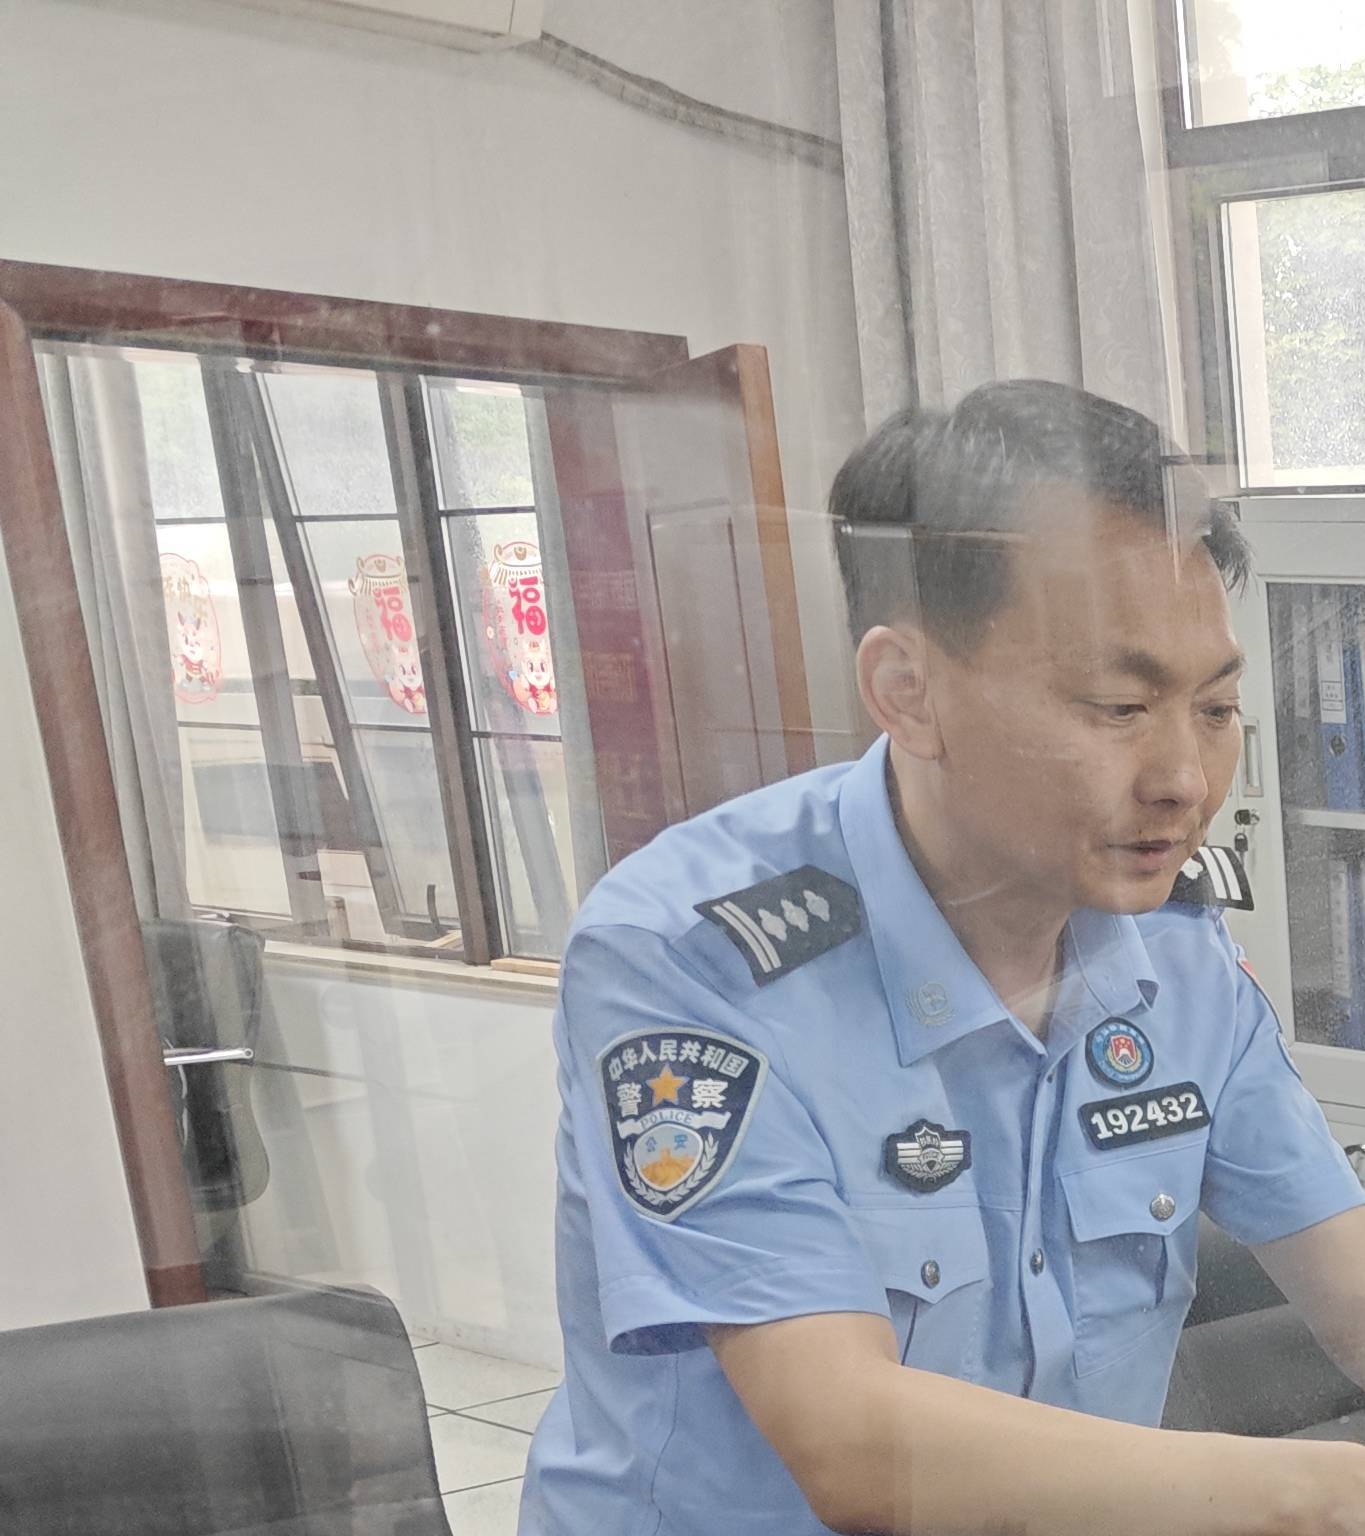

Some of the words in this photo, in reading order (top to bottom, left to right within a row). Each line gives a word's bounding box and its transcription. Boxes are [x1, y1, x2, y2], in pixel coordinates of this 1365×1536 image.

[608, 1039, 749, 1081] 中华人民共和国
[616, 1078, 728, 1117] 警察
[1091, 1093, 1203, 1140] 192432
[640, 1111, 695, 1130] POLICE
